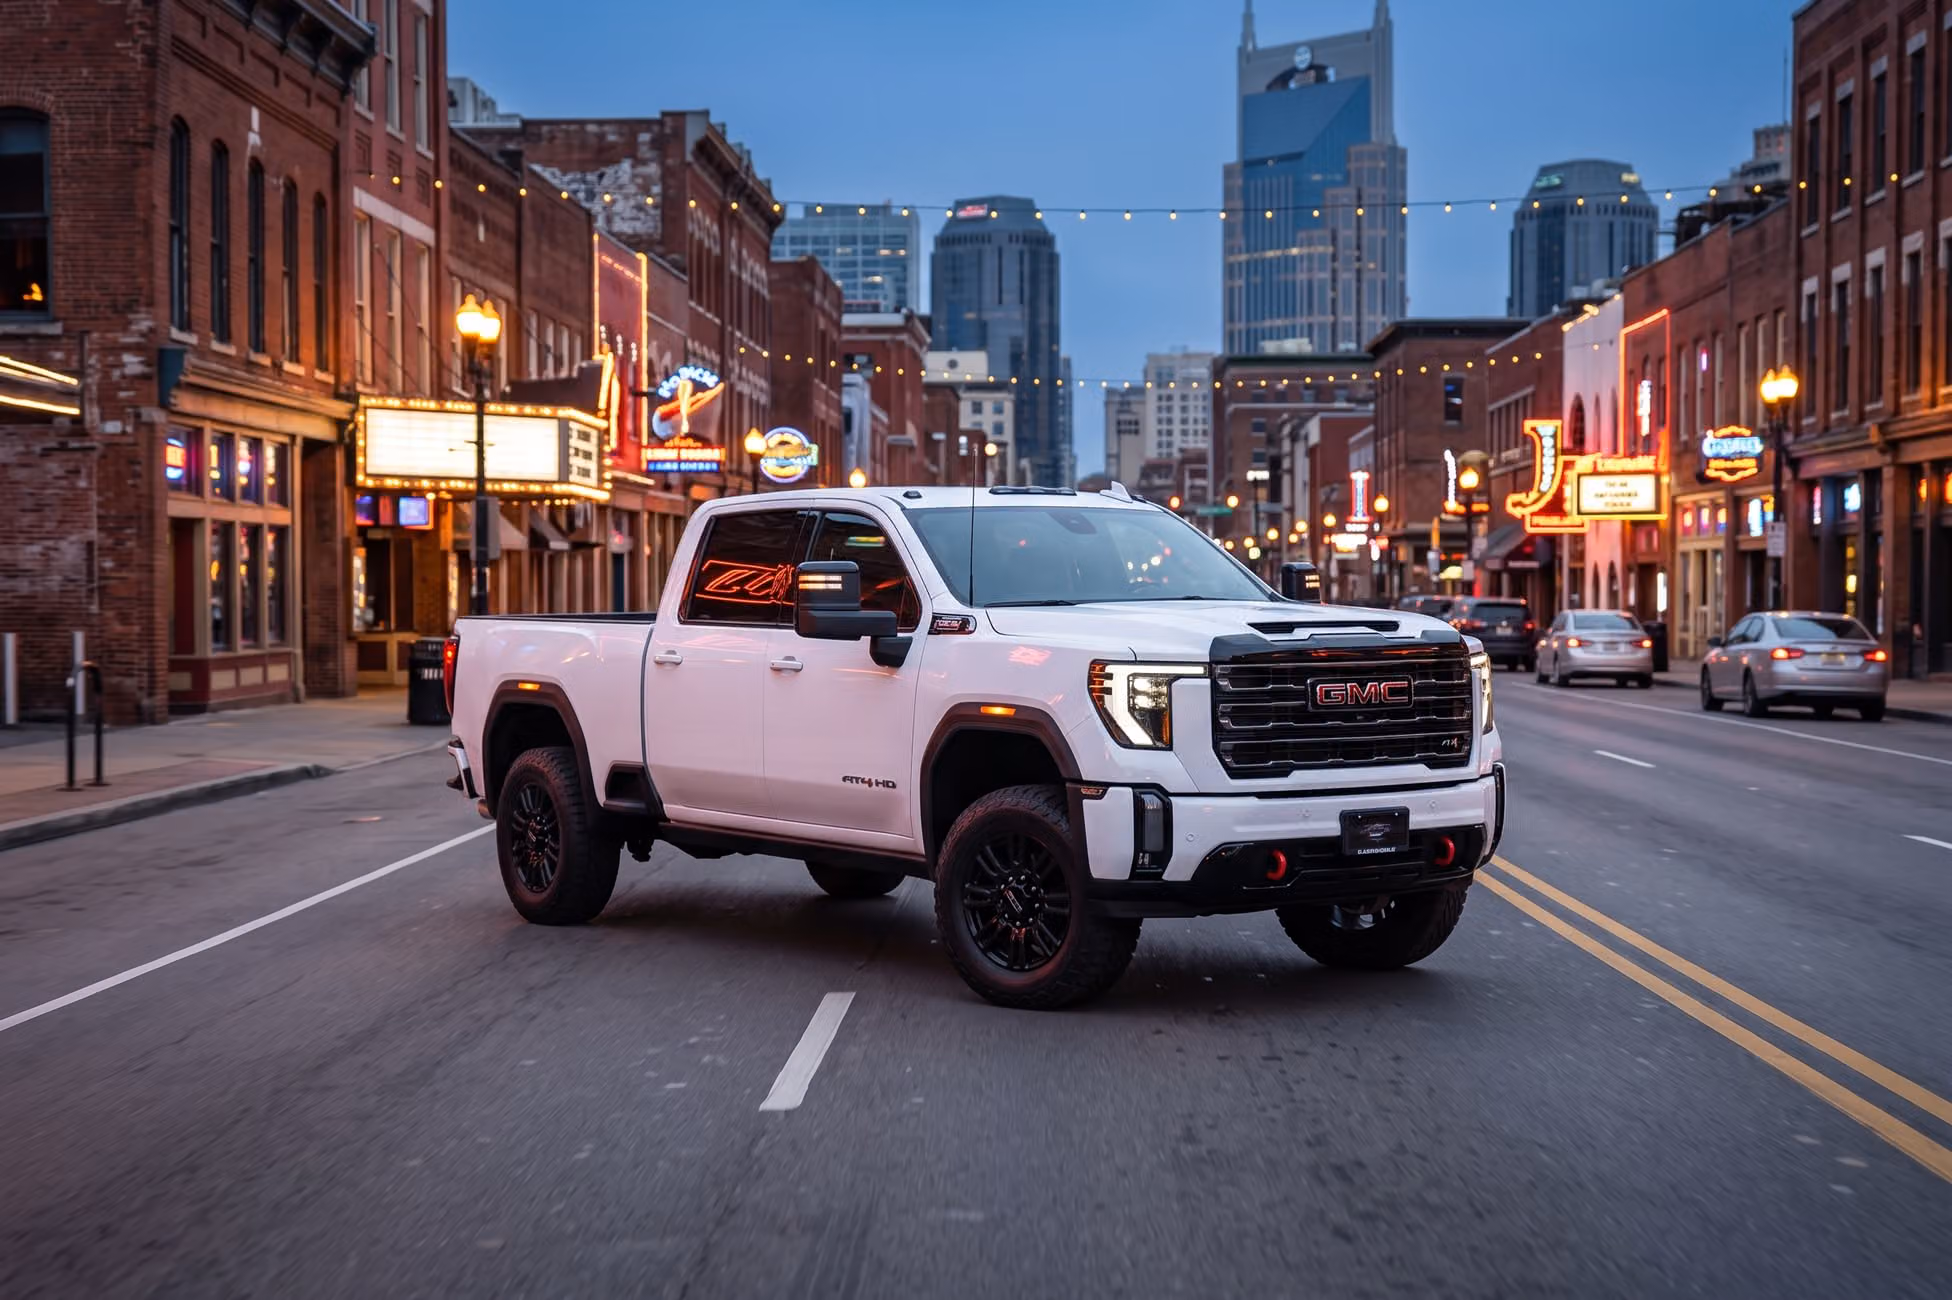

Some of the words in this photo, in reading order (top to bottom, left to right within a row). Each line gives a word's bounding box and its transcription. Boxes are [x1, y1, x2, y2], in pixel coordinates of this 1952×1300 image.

[1316, 682, 1409, 706] GMC
[842, 775, 873, 788] AT4
[875, 779, 897, 789] HD
